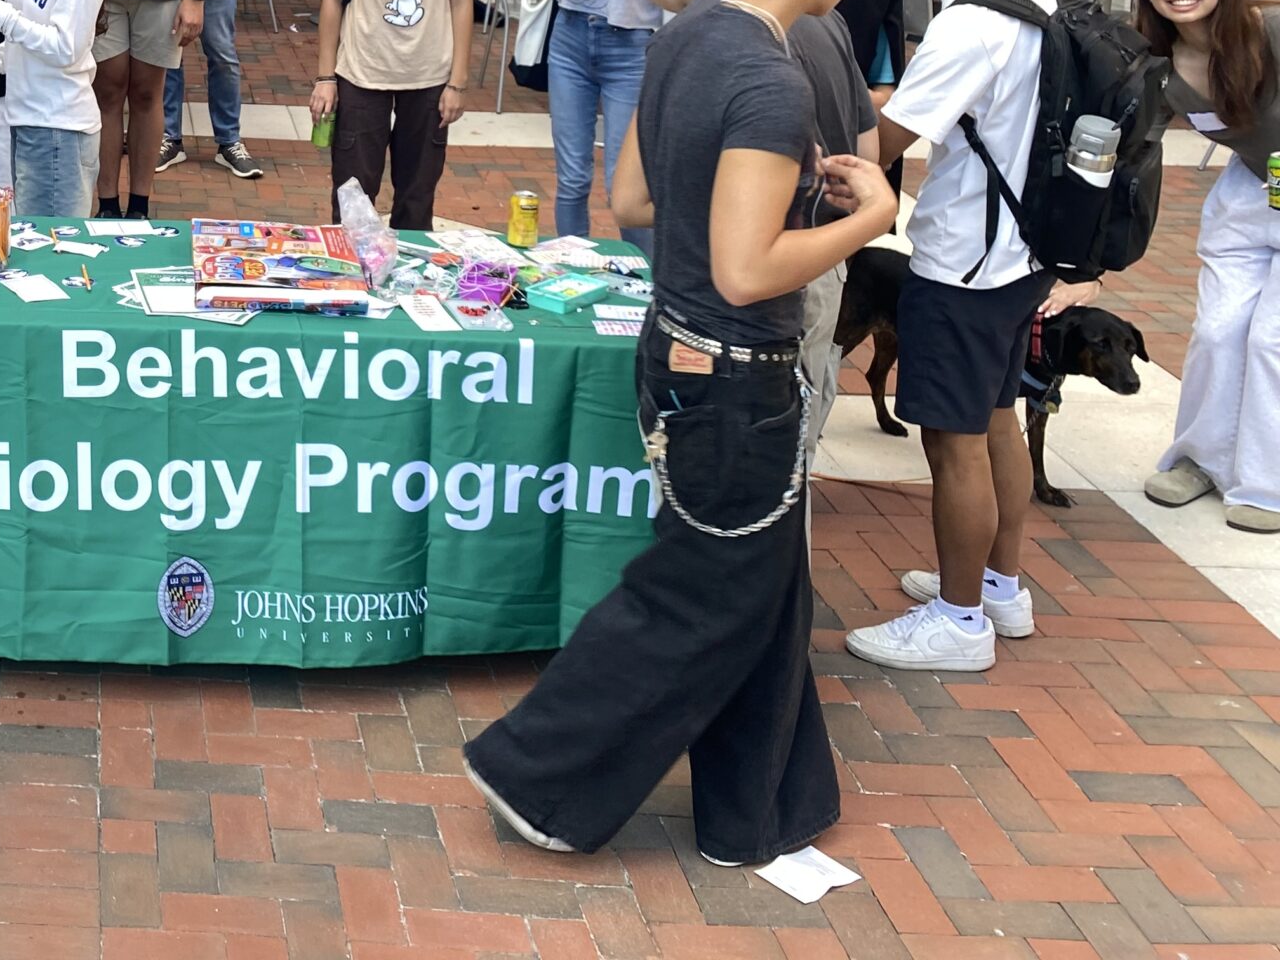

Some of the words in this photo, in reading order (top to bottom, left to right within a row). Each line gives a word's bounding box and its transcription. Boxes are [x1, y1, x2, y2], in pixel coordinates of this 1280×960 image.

[62, 329, 534, 405] Behavioral
[295, 442, 659, 532] Program
[231, 589, 315, 624] JOHNS
[324, 586, 428, 623] HOPKINS
